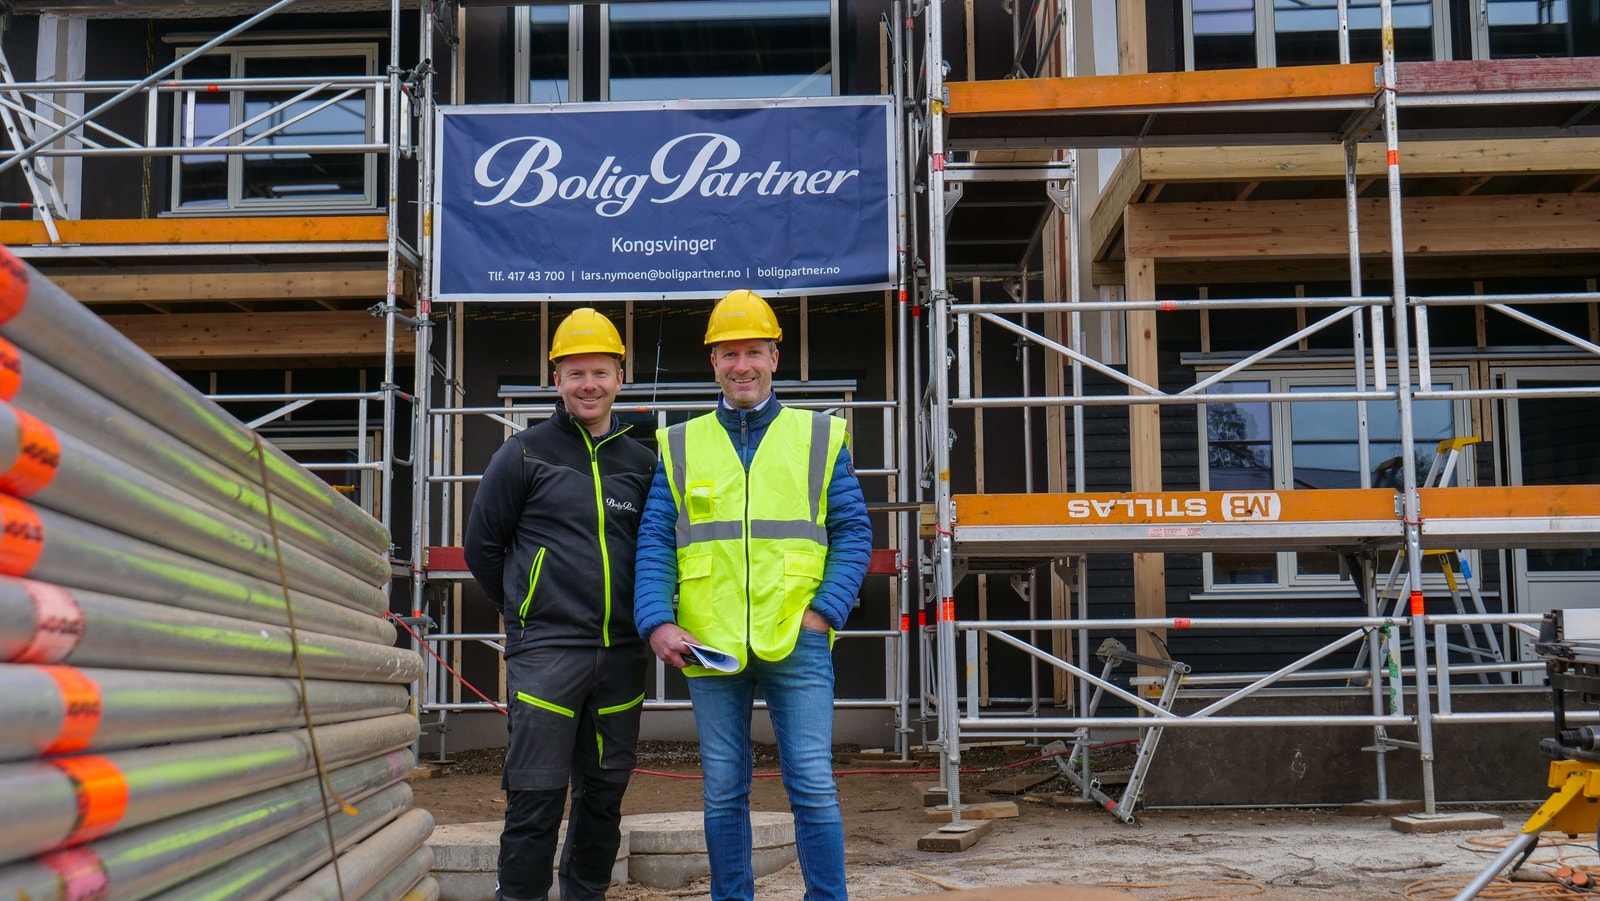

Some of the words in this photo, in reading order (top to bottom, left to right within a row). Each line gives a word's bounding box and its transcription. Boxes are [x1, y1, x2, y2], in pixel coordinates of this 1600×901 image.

[611, 235, 717, 256] Kongsvinger
[488, 271, 505, 282] Tlf.
[507, 271, 525, 281] 417
[527, 271, 541, 281] 43
[543, 270, 565, 281] 700
[581, 268, 741, 283] lars.nymoen@boligpartner.no
[757, 266, 841, 280] boligpartner.no
[1067, 498, 1208, 518] STILLAS
[1229, 495, 1272, 521] MB
